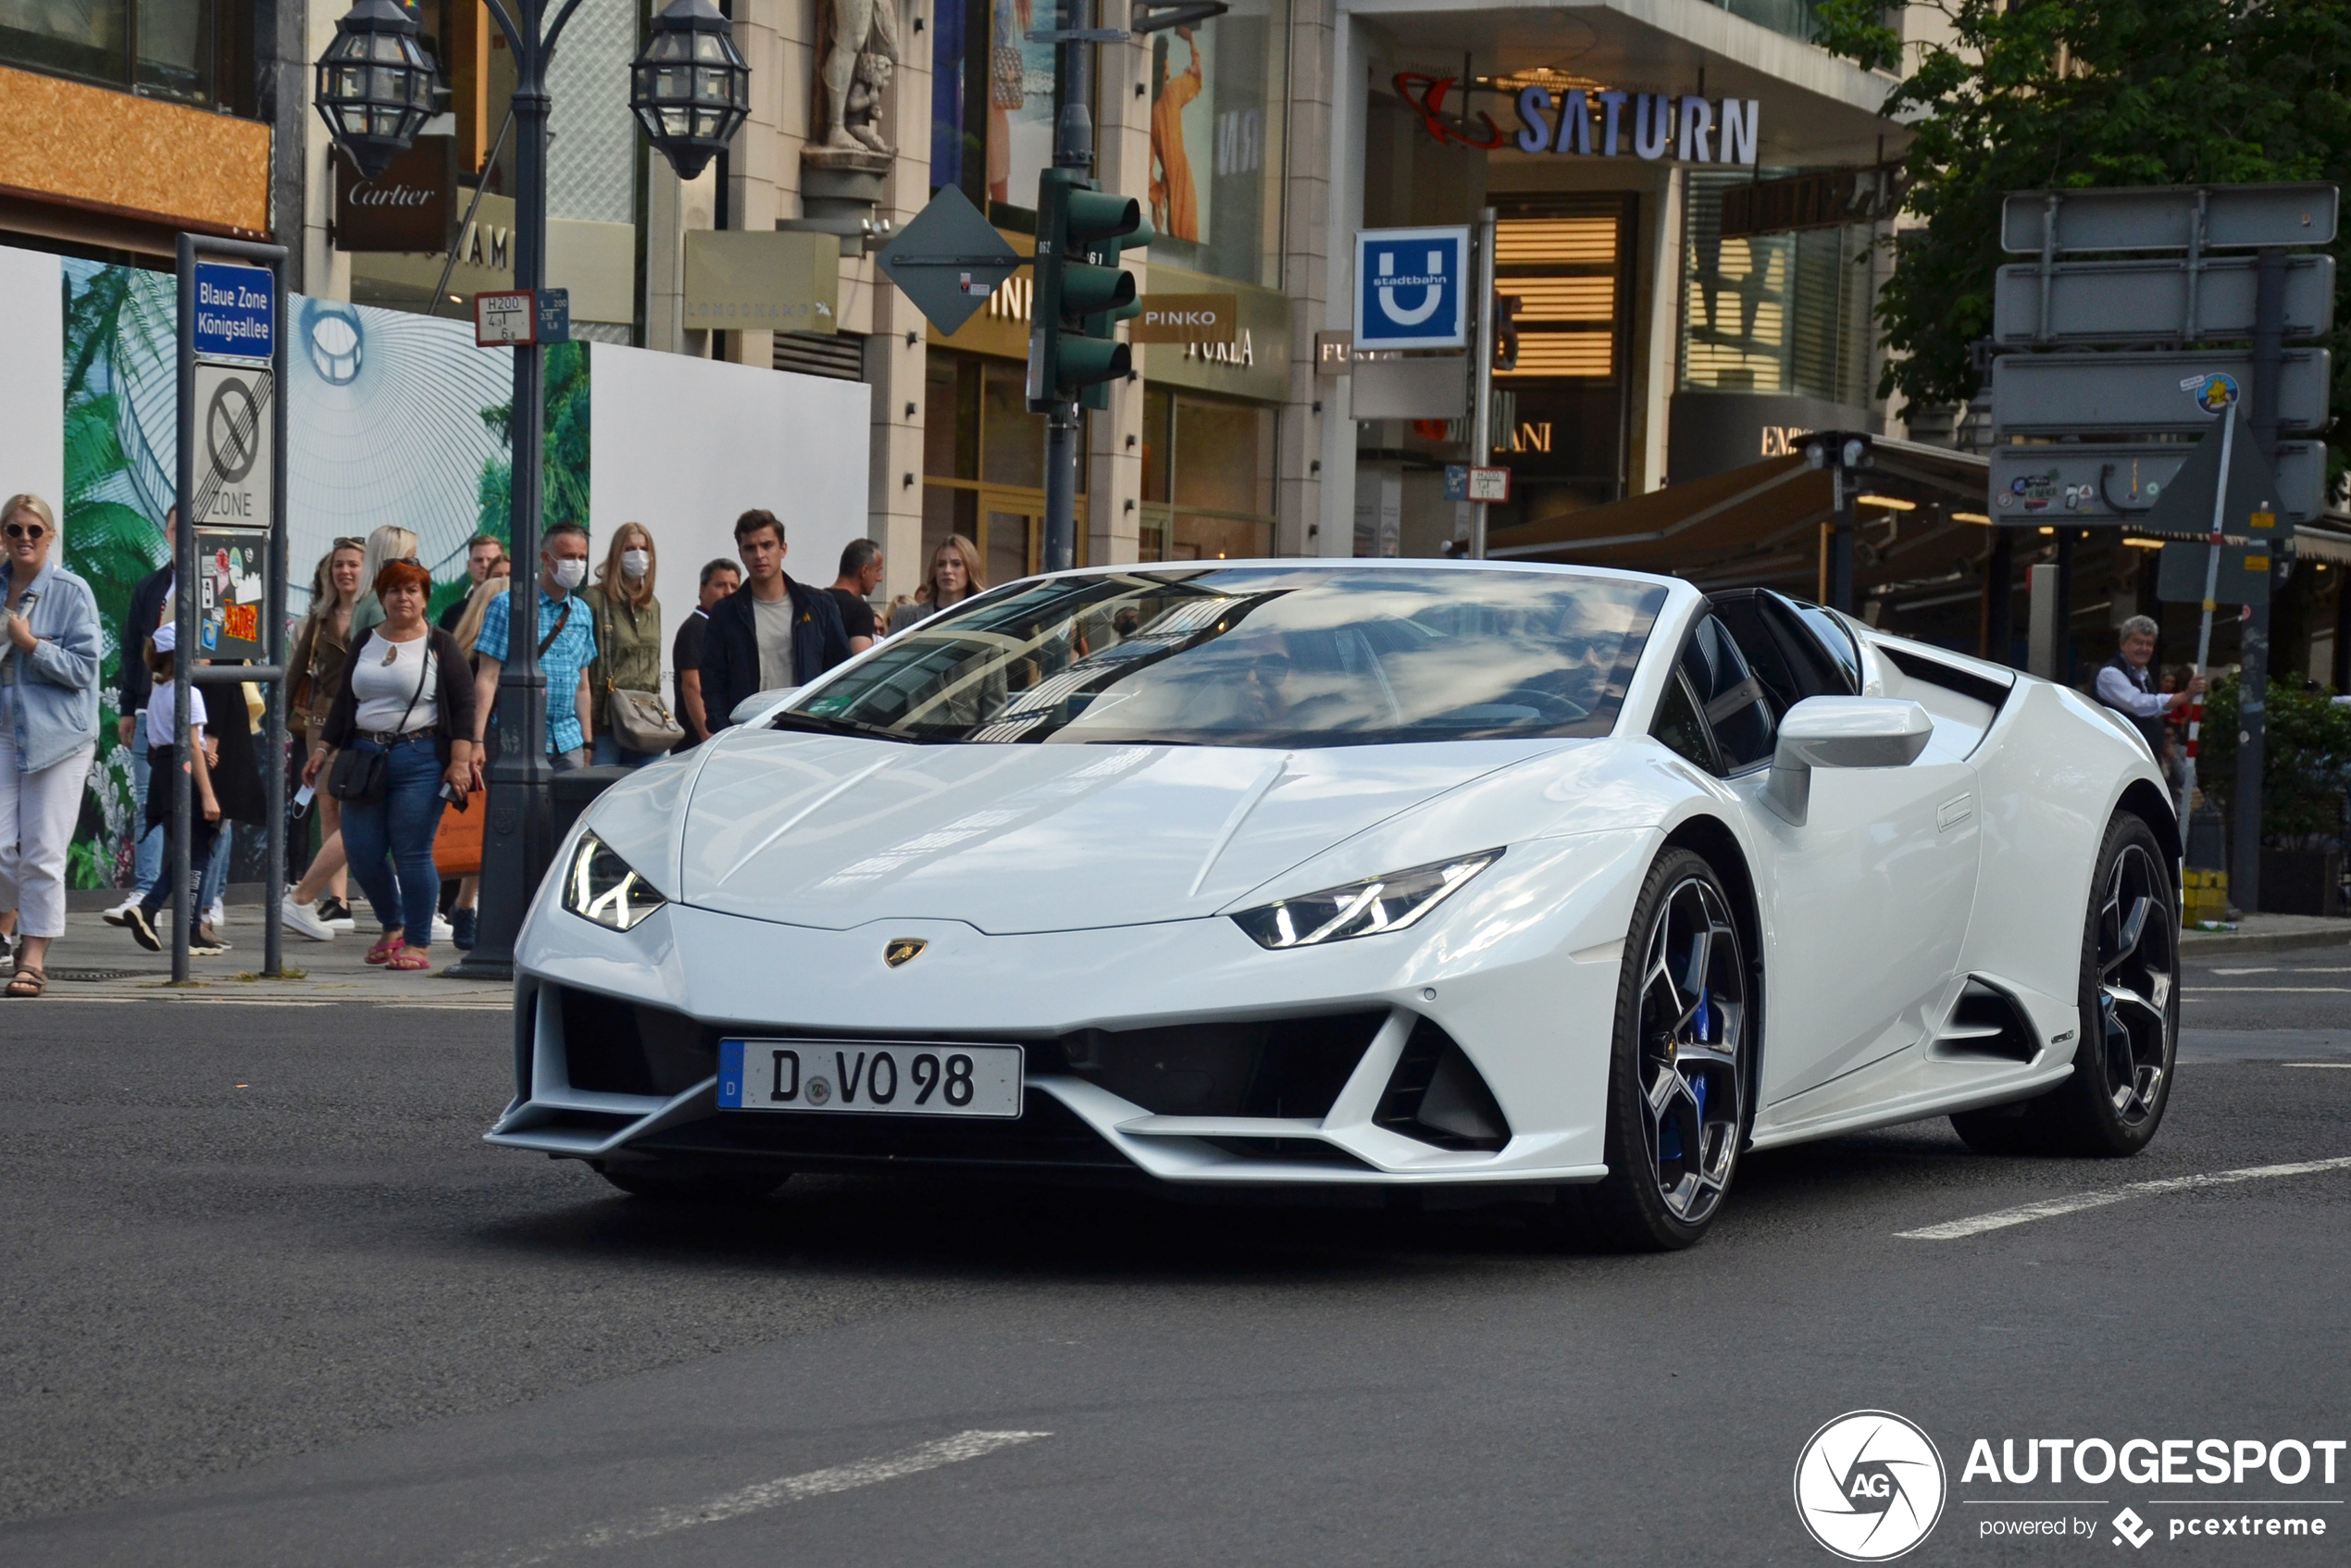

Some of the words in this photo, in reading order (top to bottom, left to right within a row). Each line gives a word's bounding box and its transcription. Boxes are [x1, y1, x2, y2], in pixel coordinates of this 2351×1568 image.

[1518, 85, 1759, 165] SATURN
[349, 180, 435, 205] Cartier
[1088, 251, 1103, 266] 61
[1374, 274, 1447, 287] stadtbahn
[200, 281, 235, 306] Blaue
[238, 285, 267, 310] Zone
[488, 297, 519, 310] H200
[554, 299, 566, 308] 200
[687, 302, 809, 317] LONGCHAMP
[1146, 311, 1216, 325] PINKO
[198, 312, 268, 342] Königsallee
[212, 492, 252, 516] ZONE
[770, 1050, 800, 1101] D
[836, 1051, 898, 1104] VO
[911, 1052, 975, 1106] 98
[726, 1081, 736, 1096] D
